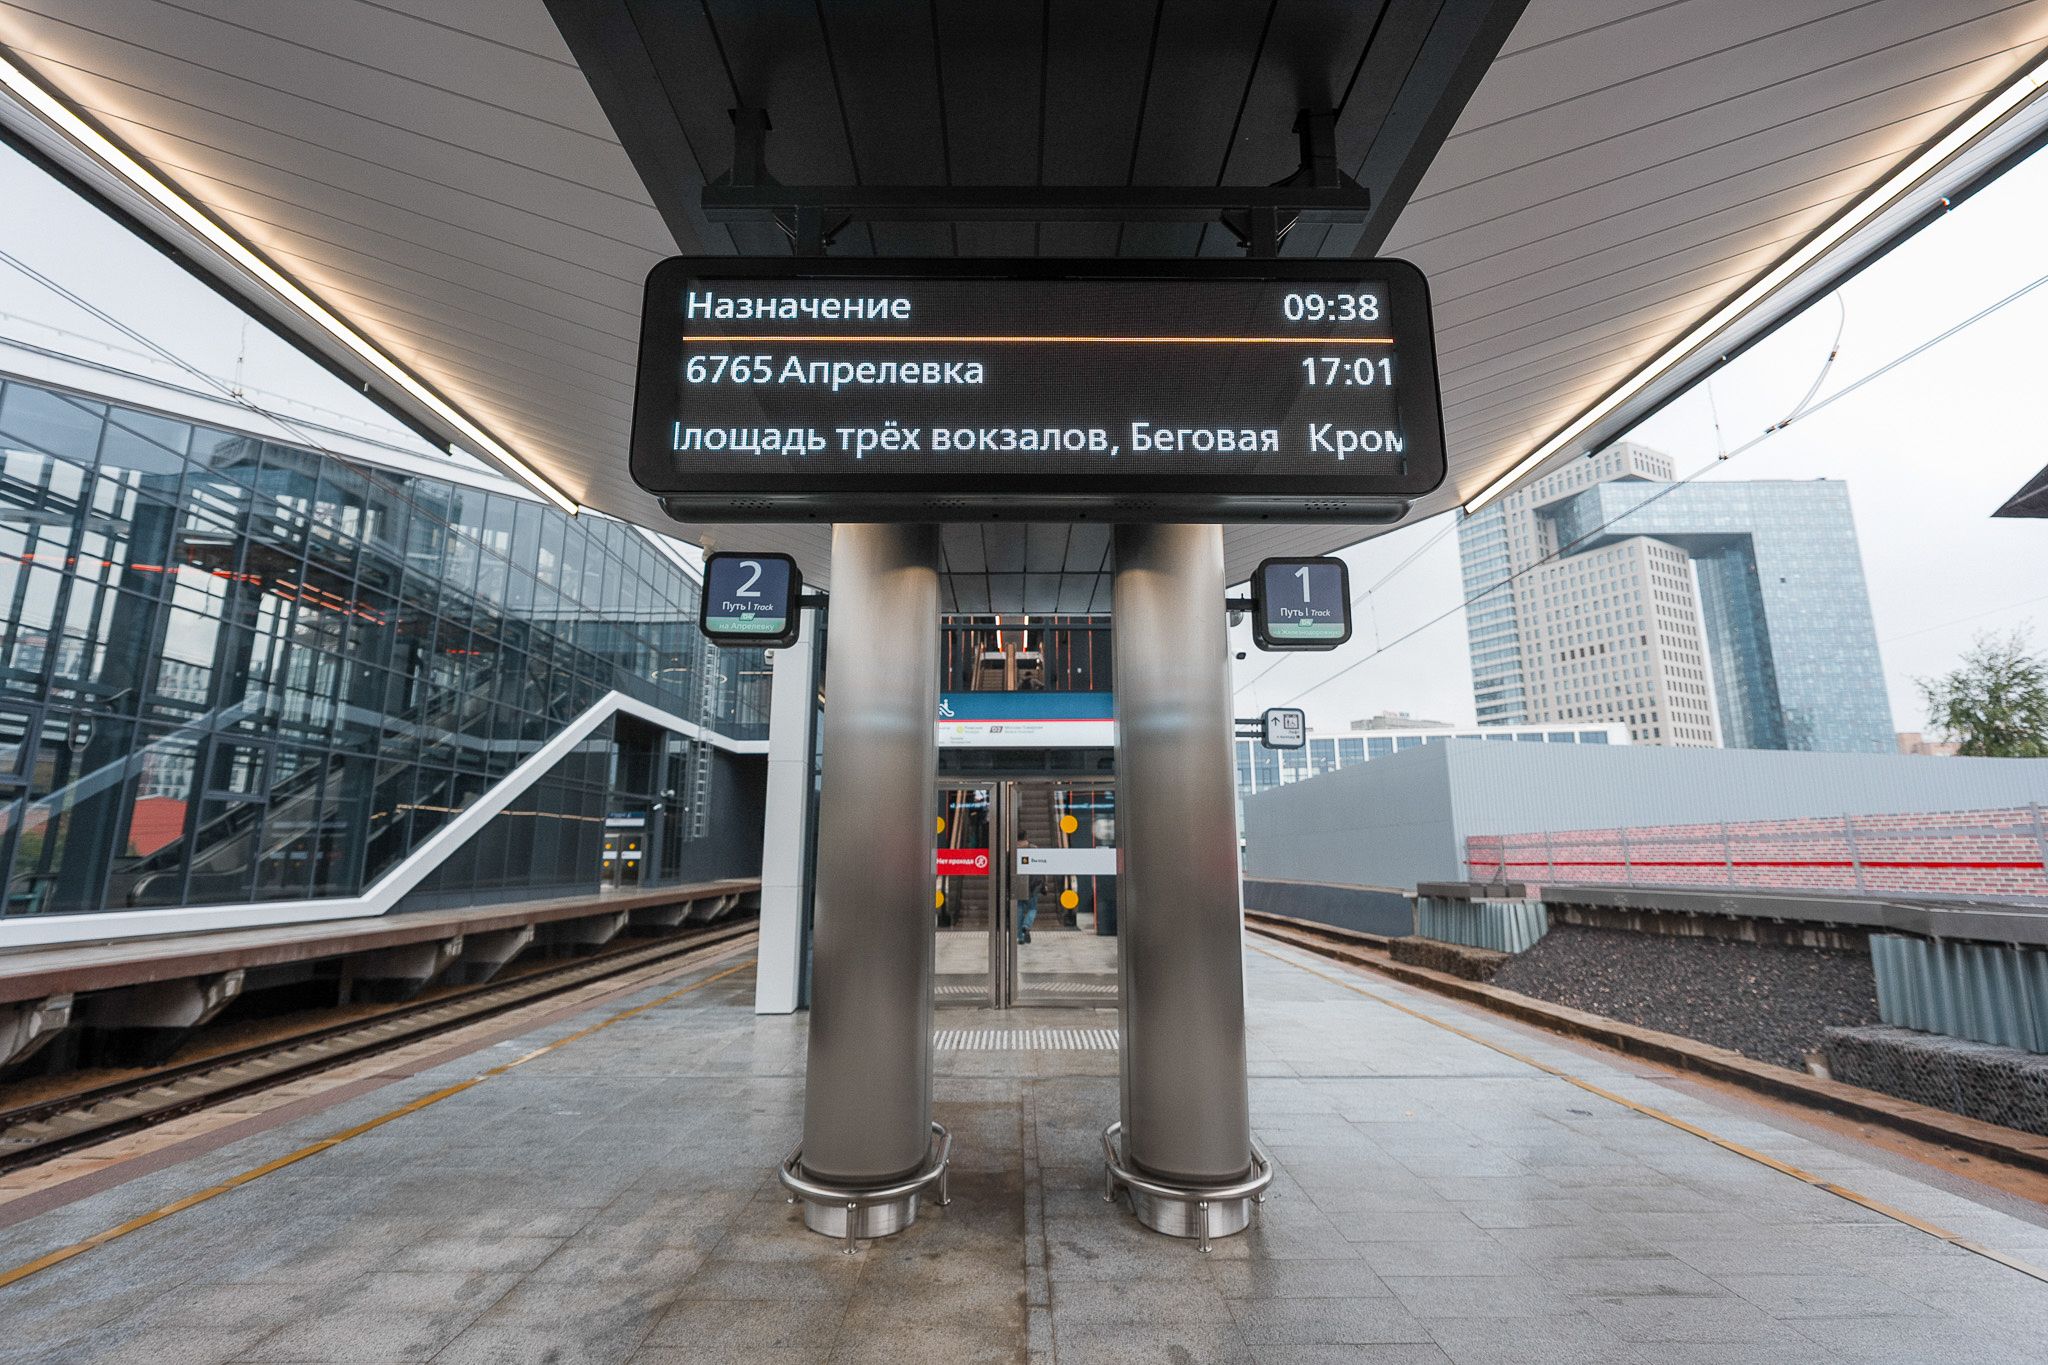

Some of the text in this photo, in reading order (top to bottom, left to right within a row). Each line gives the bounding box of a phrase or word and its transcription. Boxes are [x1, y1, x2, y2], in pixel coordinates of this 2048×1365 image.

[687, 291, 912, 319] Назначение
[1283, 291, 1380, 321] 09:38
[686, 355, 984, 392] 6765 Апрелевка
[1302, 357, 1393, 386] 17:01
[835, 420, 921, 459] трёх
[931, 428, 1120, 456] вокзалов,
[1131, 421, 1279, 453] Беговая
[736, 560, 762, 597] 2
[1294, 566, 1311, 603] 1
[722, 601, 774, 613] Путь Track
[1280, 607, 1331, 619] Путь Track
